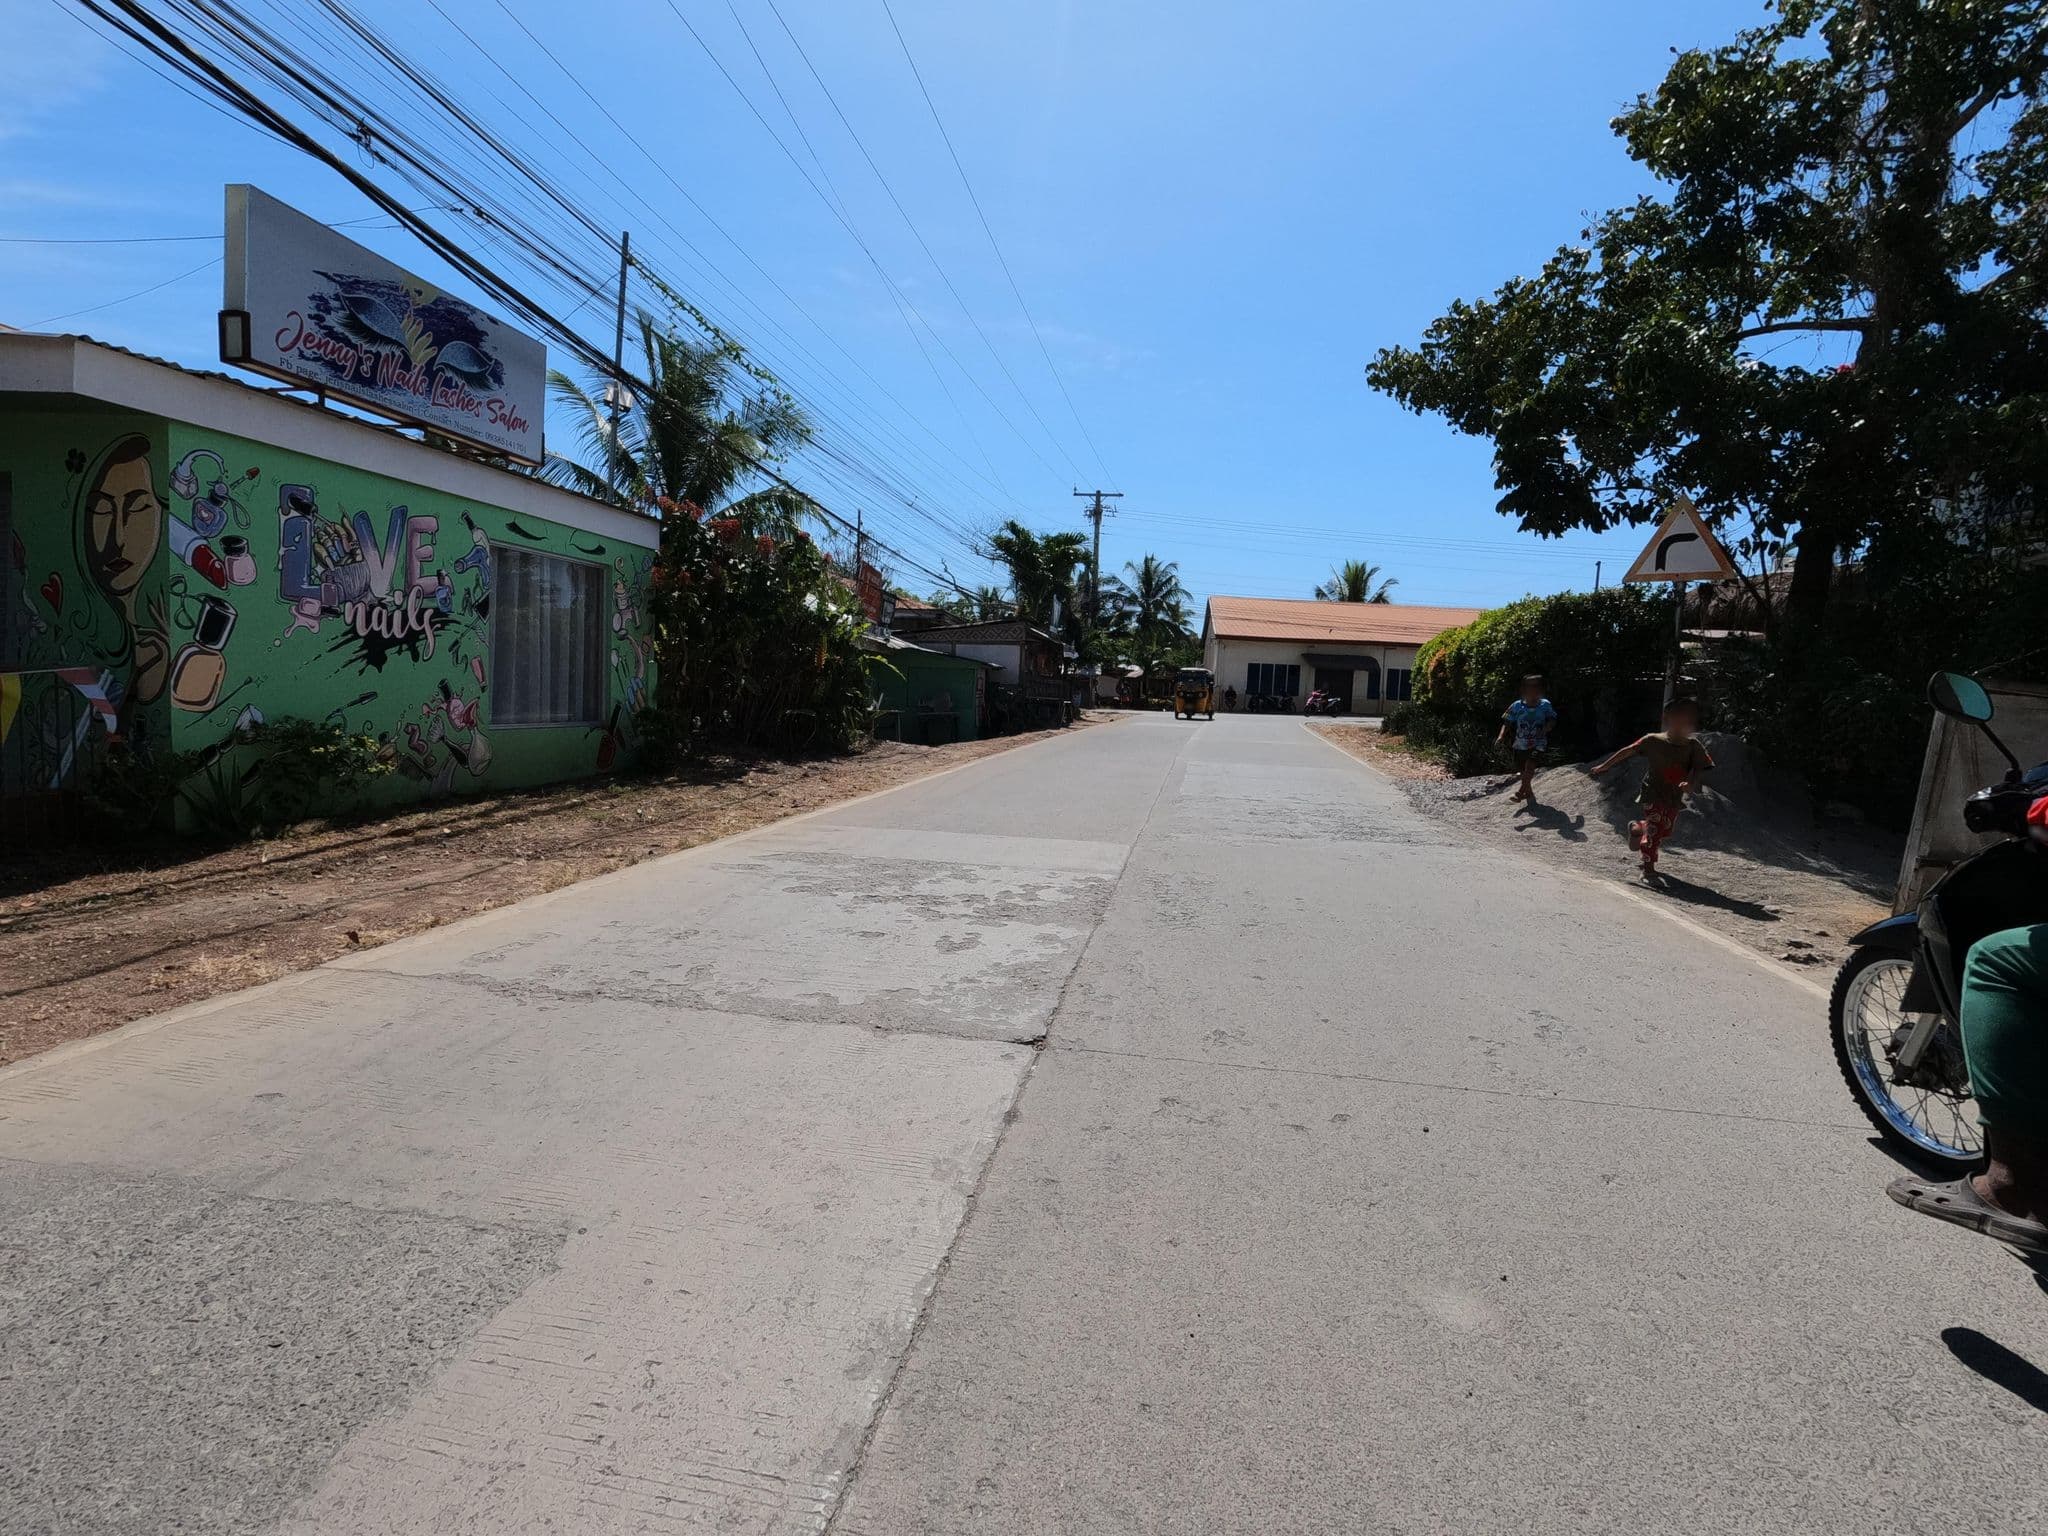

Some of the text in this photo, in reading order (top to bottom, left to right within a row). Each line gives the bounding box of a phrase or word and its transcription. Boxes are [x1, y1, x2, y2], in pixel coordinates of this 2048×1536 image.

[274, 310, 530, 434] Jenny's Nails Lashes Salon
[279, 356, 293, 370] Fb
[344, 584, 442, 662] nails
